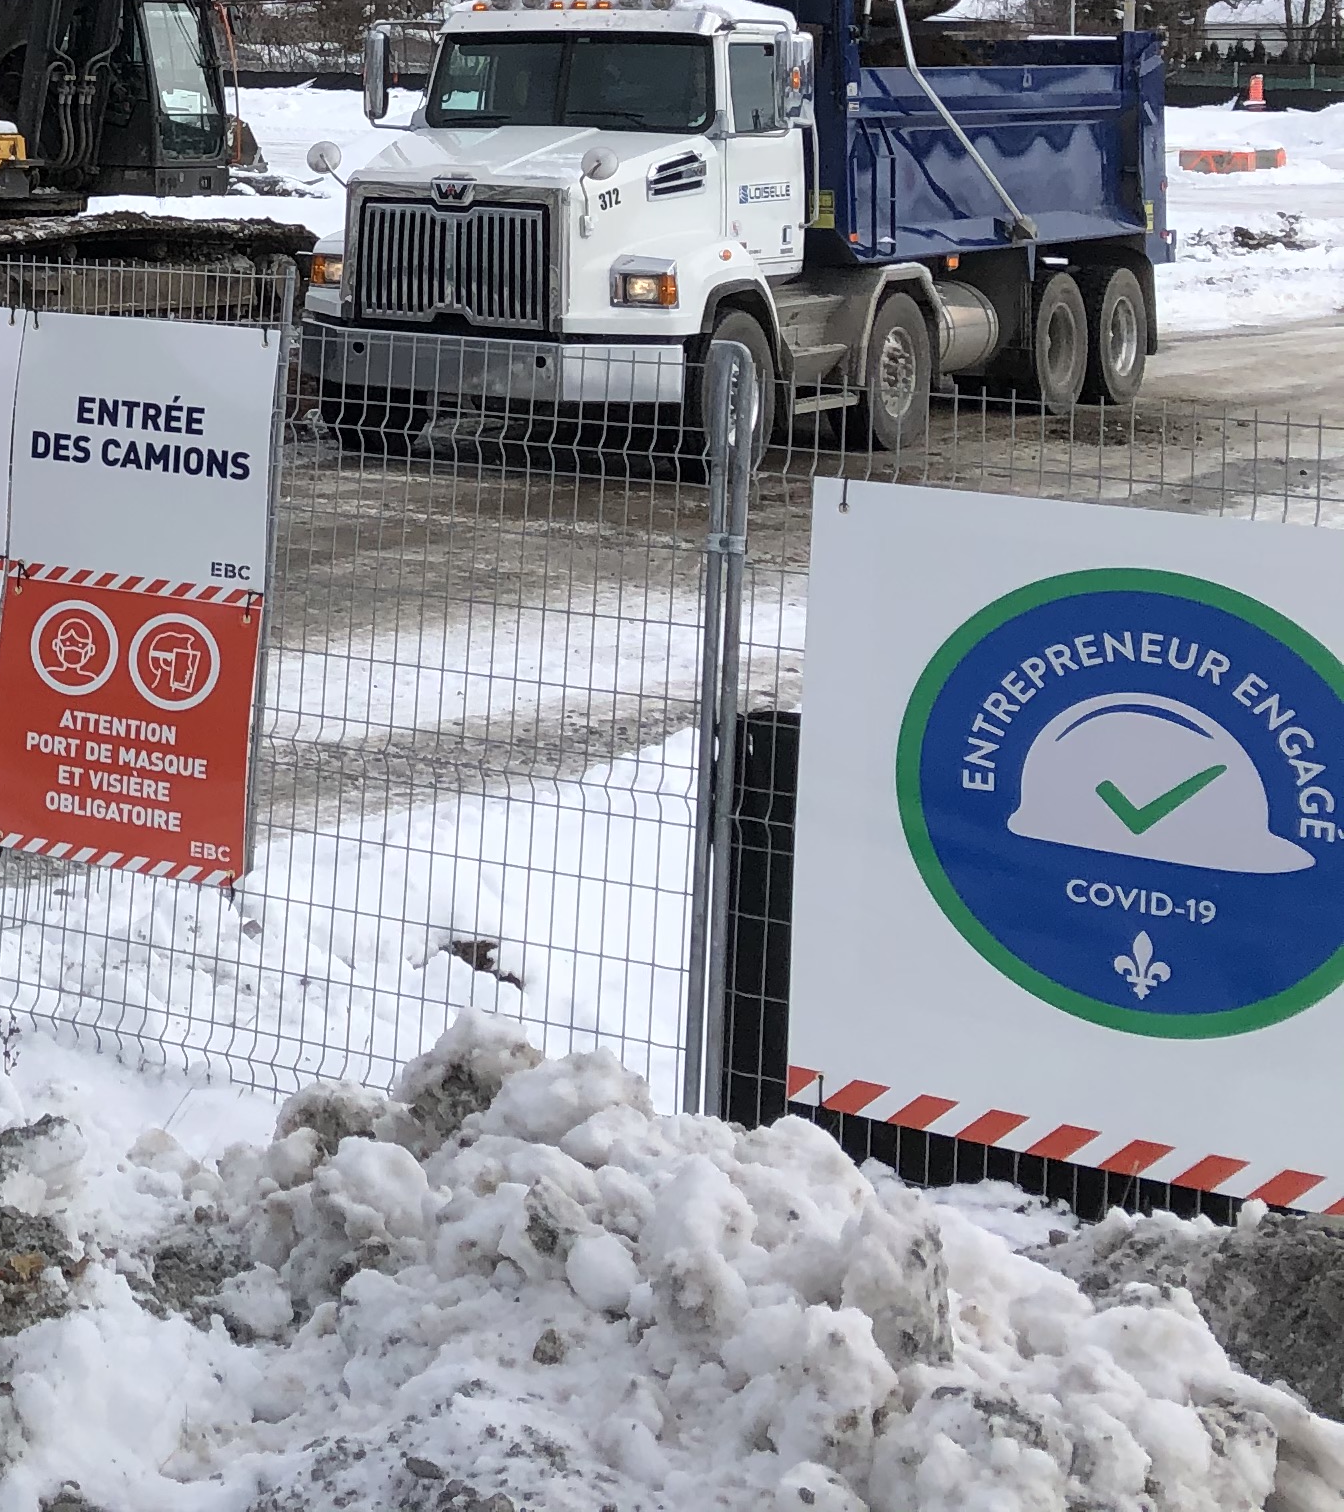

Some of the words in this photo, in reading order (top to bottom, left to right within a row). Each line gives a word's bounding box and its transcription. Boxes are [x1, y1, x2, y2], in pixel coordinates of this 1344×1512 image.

[598, 187, 622, 210] 372
[749, 184, 791, 199] LOISELLE
[76, 395, 205, 435] ENTRÉE
[30, 431, 92, 463] DES
[100, 438, 251, 480] CAMIONS
[210, 561, 251, 581] EBC
[59, 708, 177, 746] ATTENTION
[961, 630, 1231, 792] ENTREPRENEUR
[26, 731, 81, 758] PORT
[85, 740, 113, 764] DE
[118, 746, 208, 779] MASQUE
[58, 764, 84, 787] ET
[89, 771, 171, 802] VISIÈRE
[45, 791, 182, 832] OBLIGATOIRE
[189, 840, 231, 863] EBC
[1065, 878, 1218, 924] COVID-19
